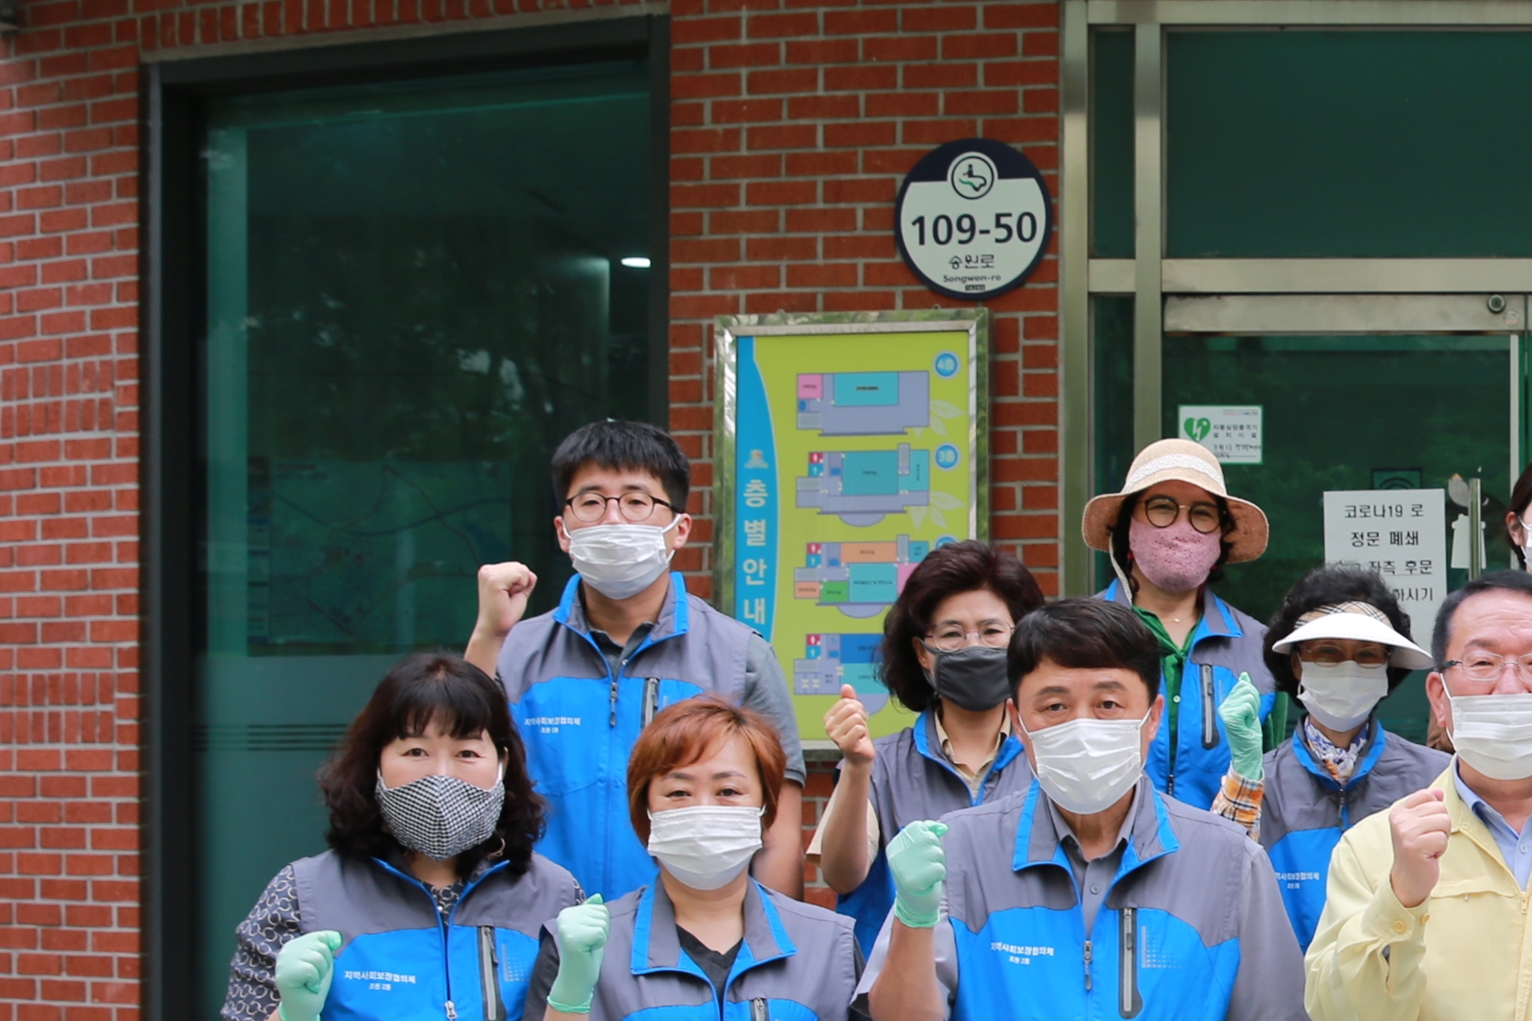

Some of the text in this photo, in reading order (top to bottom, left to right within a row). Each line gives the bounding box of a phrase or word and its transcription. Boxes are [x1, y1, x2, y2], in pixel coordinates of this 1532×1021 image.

[911, 212, 1038, 246] 109-50
[948, 254, 995, 270] 송원로
[943, 274, 1001, 284] Songwon-ro
[1344, 503, 1425, 519] 코로나19 로
[1351, 531, 1380, 548] 정문
[1405, 559, 1433, 575] 후문
